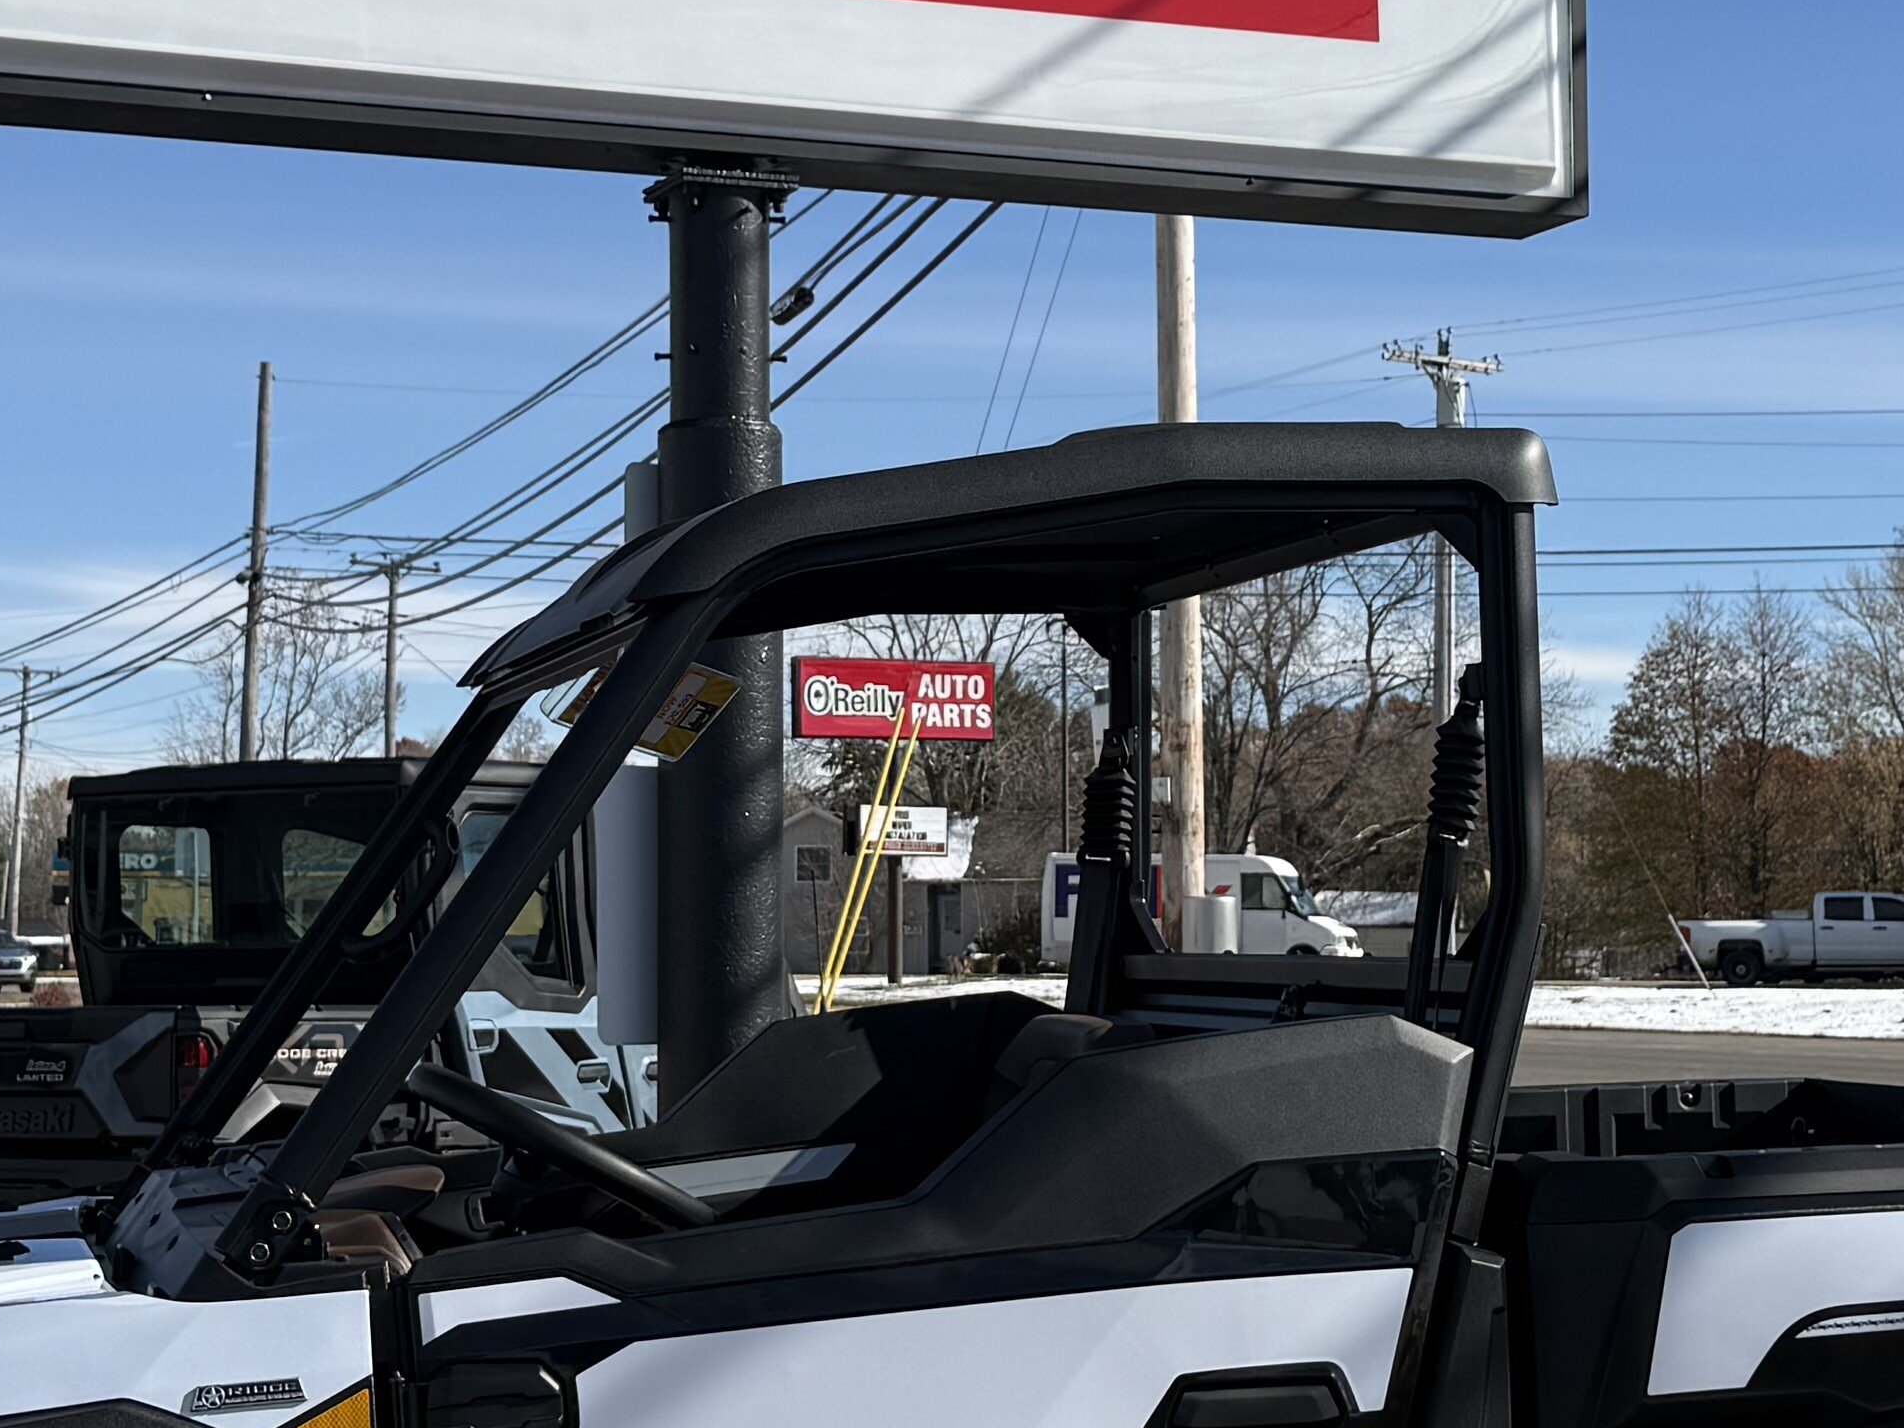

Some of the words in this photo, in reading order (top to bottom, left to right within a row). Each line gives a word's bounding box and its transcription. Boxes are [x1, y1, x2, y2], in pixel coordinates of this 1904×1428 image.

[804, 675, 905, 721] O'Reilly
[917, 672, 985, 700] AUTO
[911, 702, 992, 729] PARTS
